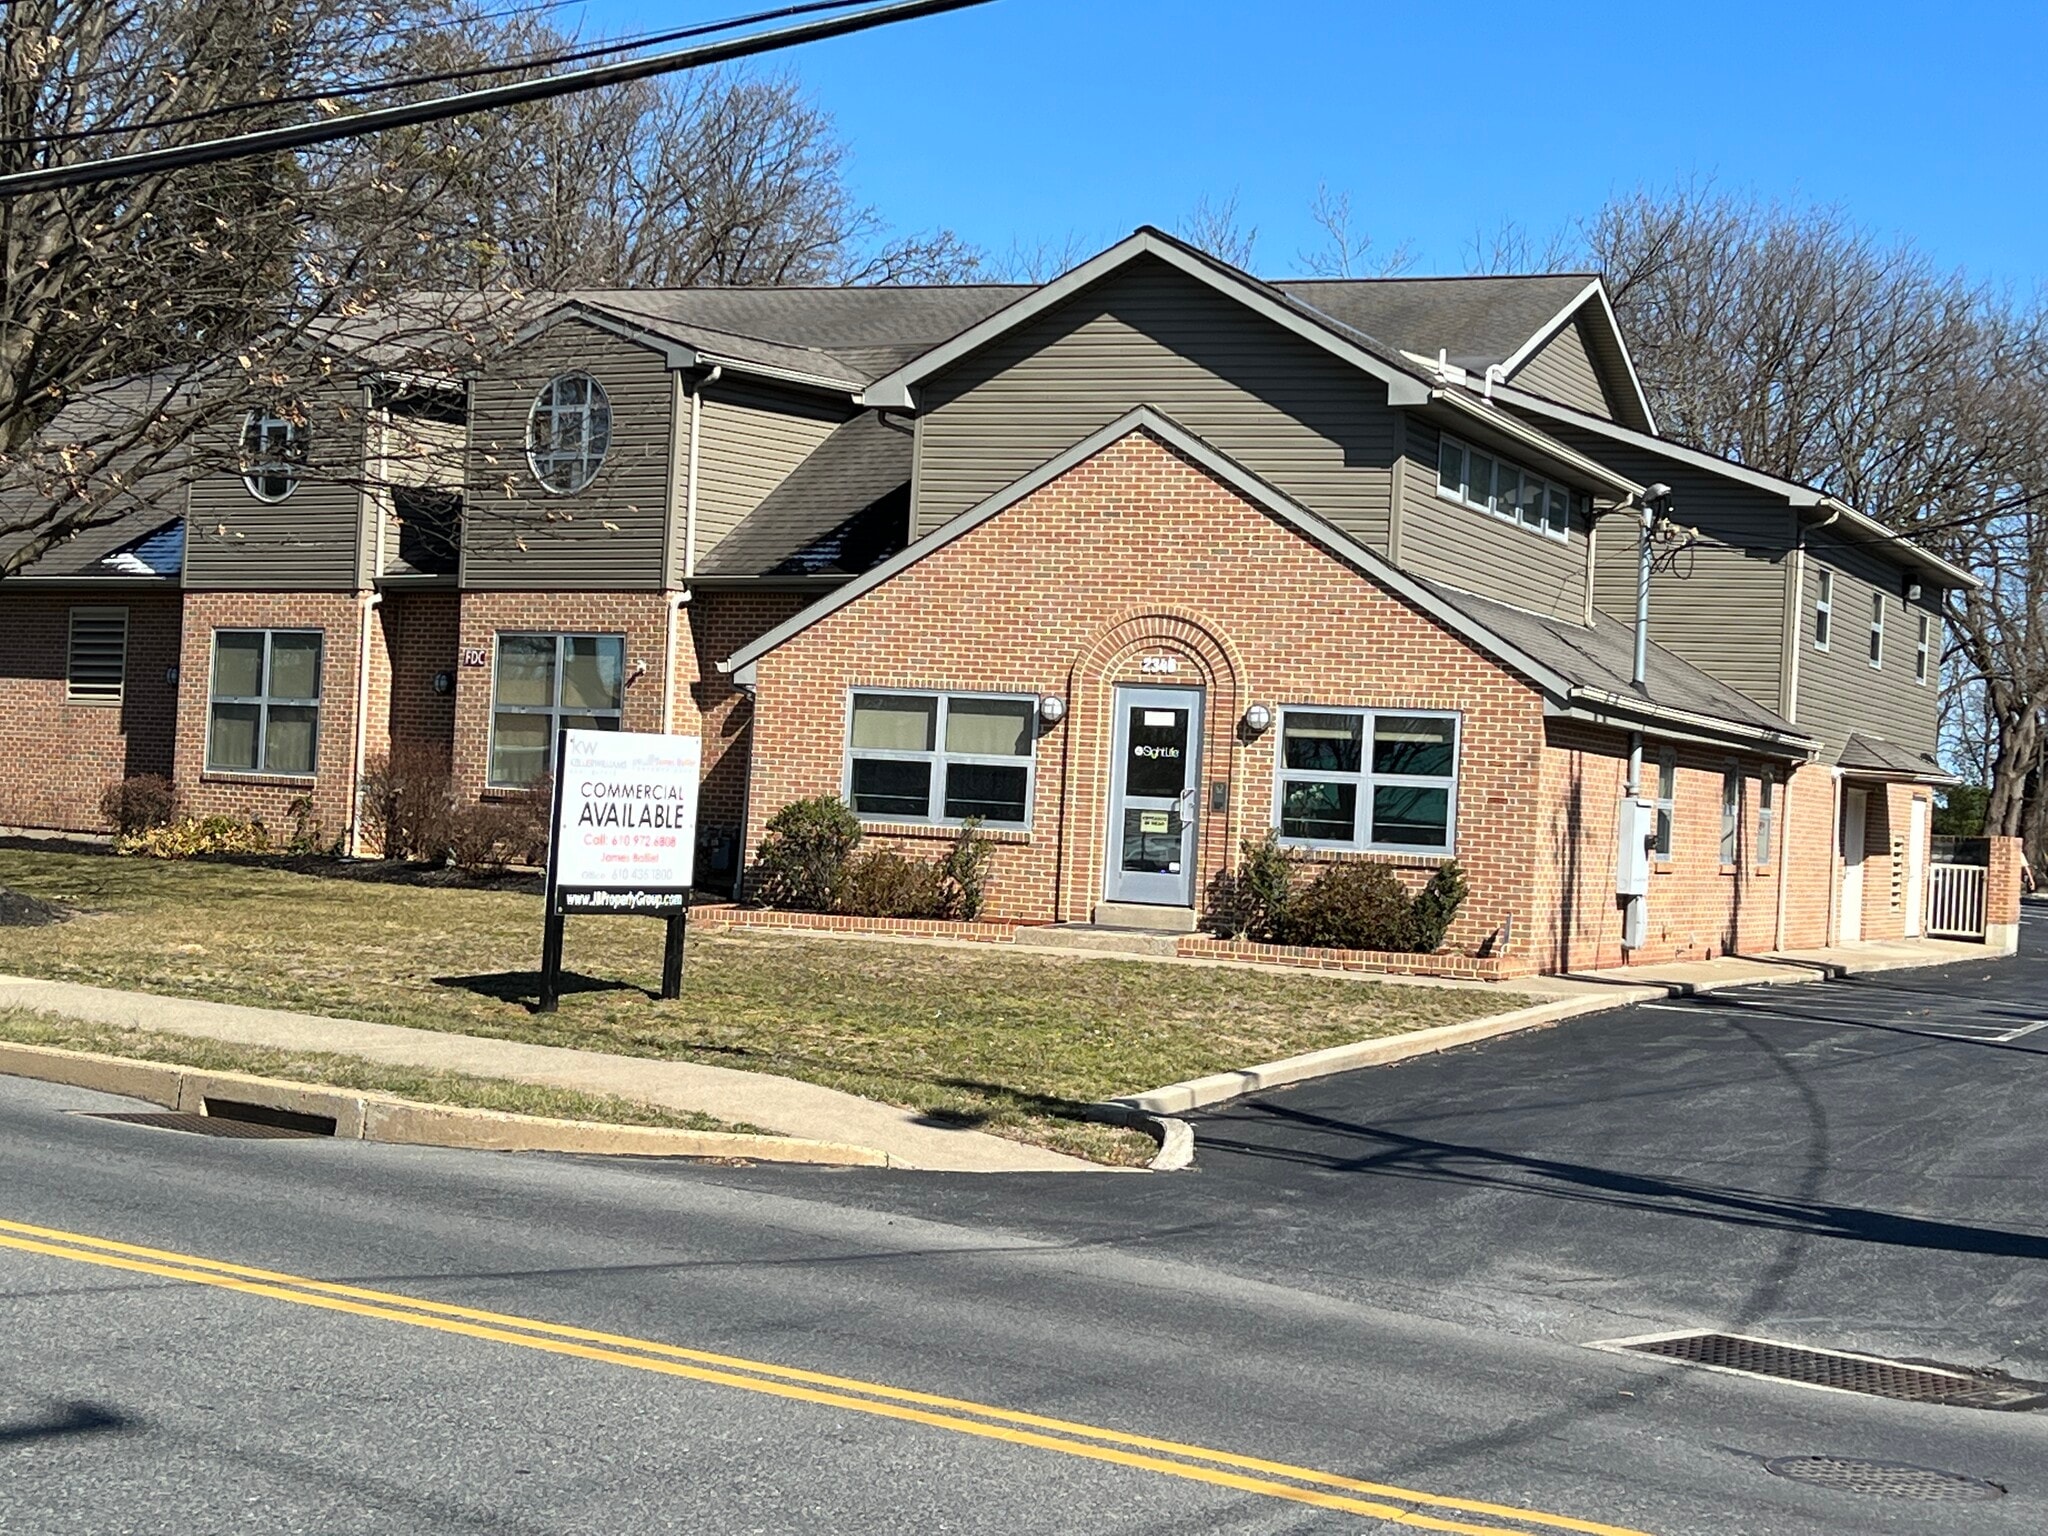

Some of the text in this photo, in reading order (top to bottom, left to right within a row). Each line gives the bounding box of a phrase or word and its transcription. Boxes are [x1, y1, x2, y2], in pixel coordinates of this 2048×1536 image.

[465, 650, 485, 665] FDC
[581, 782, 684, 801] COMMERCIAL
[578, 802, 684, 829] AVAILABLE
